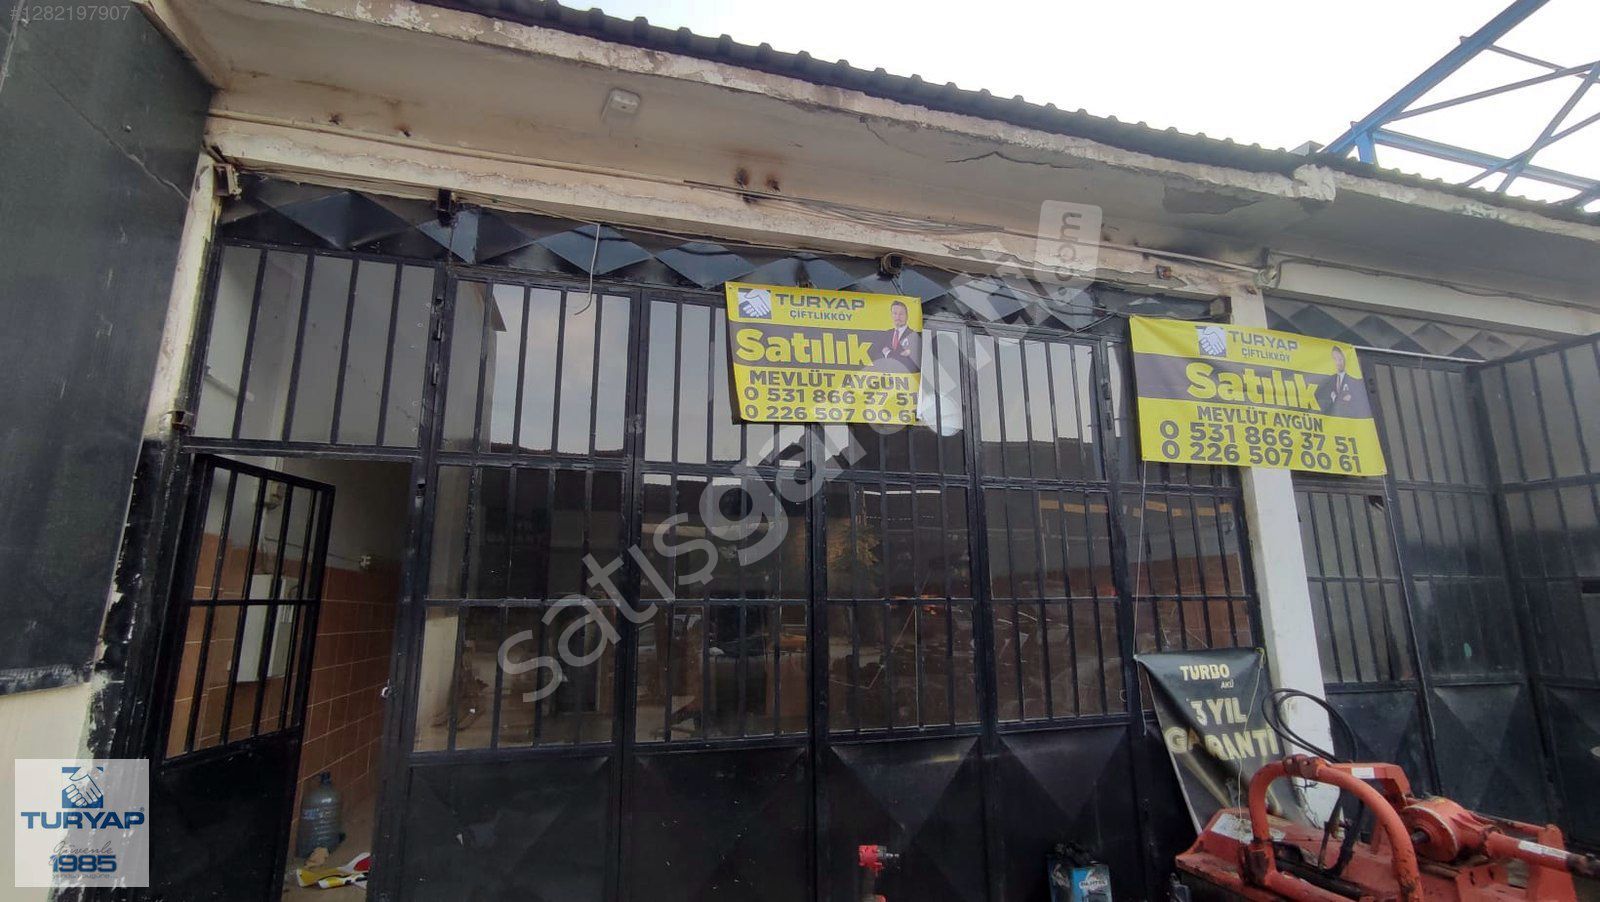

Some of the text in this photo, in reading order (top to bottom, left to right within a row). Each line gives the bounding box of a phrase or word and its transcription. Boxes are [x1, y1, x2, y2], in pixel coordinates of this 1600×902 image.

[775, 293, 866, 311] TURYAP
[735, 328, 873, 367] Satılık
[1229, 330, 1298, 352] TURYAP
[749, 369, 910, 391] MEVLÜT AYGÜN
[1186, 362, 1321, 411] Satılık
[744, 386, 918, 407] 0 531 866 37 51
[745, 404, 759, 420] 0
[766, 405, 808, 421] 226
[815, 407, 856, 422] 507
[862, 408, 892, 423] 00
[1197, 405, 1323, 433] MEVLÜT AYGÜN
[1160, 420, 1358, 455] 0 531 866 37 51
[1161, 440, 1362, 474] 0 226 507 00 61
[1179, 663, 1230, 681] TURBO
[1190, 697, 1247, 727] 3 YIL
